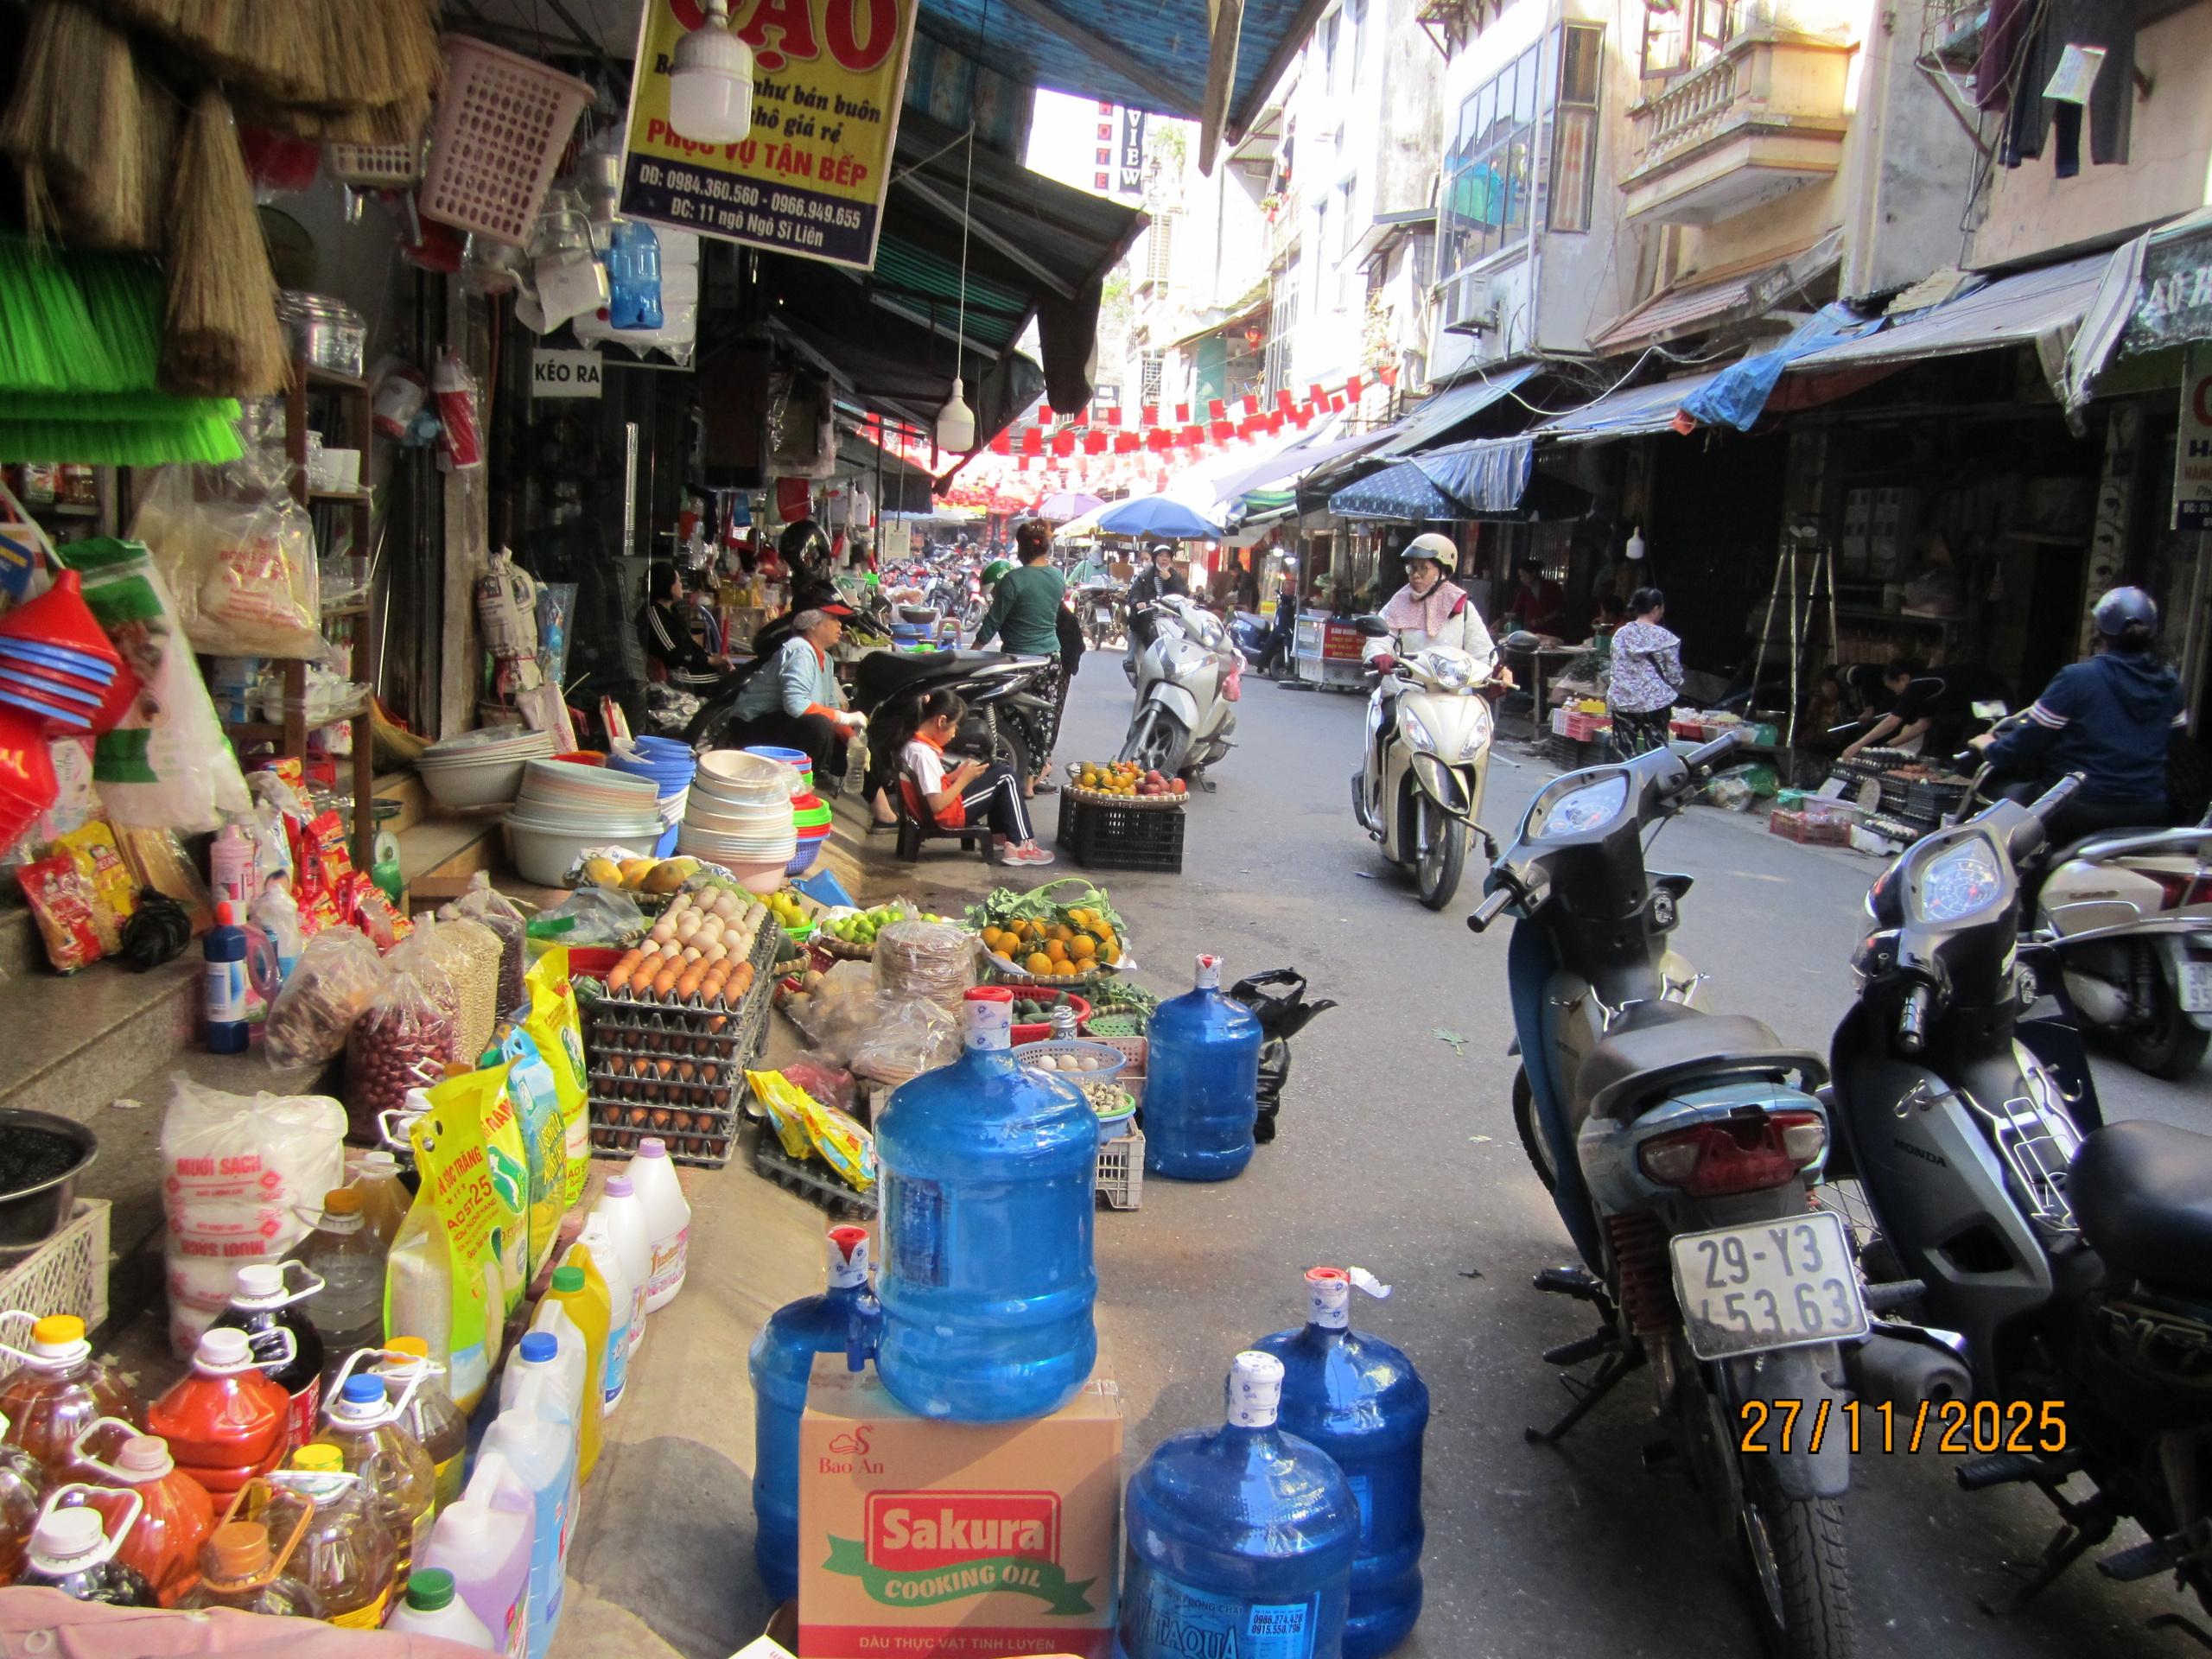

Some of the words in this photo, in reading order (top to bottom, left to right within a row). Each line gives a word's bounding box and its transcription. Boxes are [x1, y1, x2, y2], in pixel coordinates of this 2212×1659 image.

[669, 0, 899, 73] ẠO
[753, 78, 791, 101] như
[793, 85, 829, 111] bán
[834, 94, 880, 123] buôn
[784, 114, 815, 137] giá
[821, 122, 843, 143] rẻ
[1122, 110, 1141, 185] VIEW
[766, 142, 812, 177] TẬN
[819, 154, 868, 188] BẾP
[667, 170, 760, 207] 0984.360.560
[771, 193, 861, 230] 0966.949.655
[671, 197, 695, 219] ĐC:
[700, 203, 715, 223] 11
[747, 213, 774, 237] Ngô
[795, 224, 823, 247] Liên
[536, 359, 570, 382] KÉO
[577, 365, 600, 383] RA
[1894, 1139, 1947, 1167] HONDA
[1698, 1224, 1823, 1288] 29-Y3
[859, 1458, 884, 1474] An
[882, 1508, 1045, 1550] Sakura
[885, 1565, 996, 1599] COOKING
[1001, 1565, 1041, 1588] OIL
[1219, 1604, 1243, 1615] CHAI
[894, 1637, 935, 1651] THỰC
[971, 1637, 1003, 1649] TINH
[1007, 1637, 1056, 1651] LUYỆN
